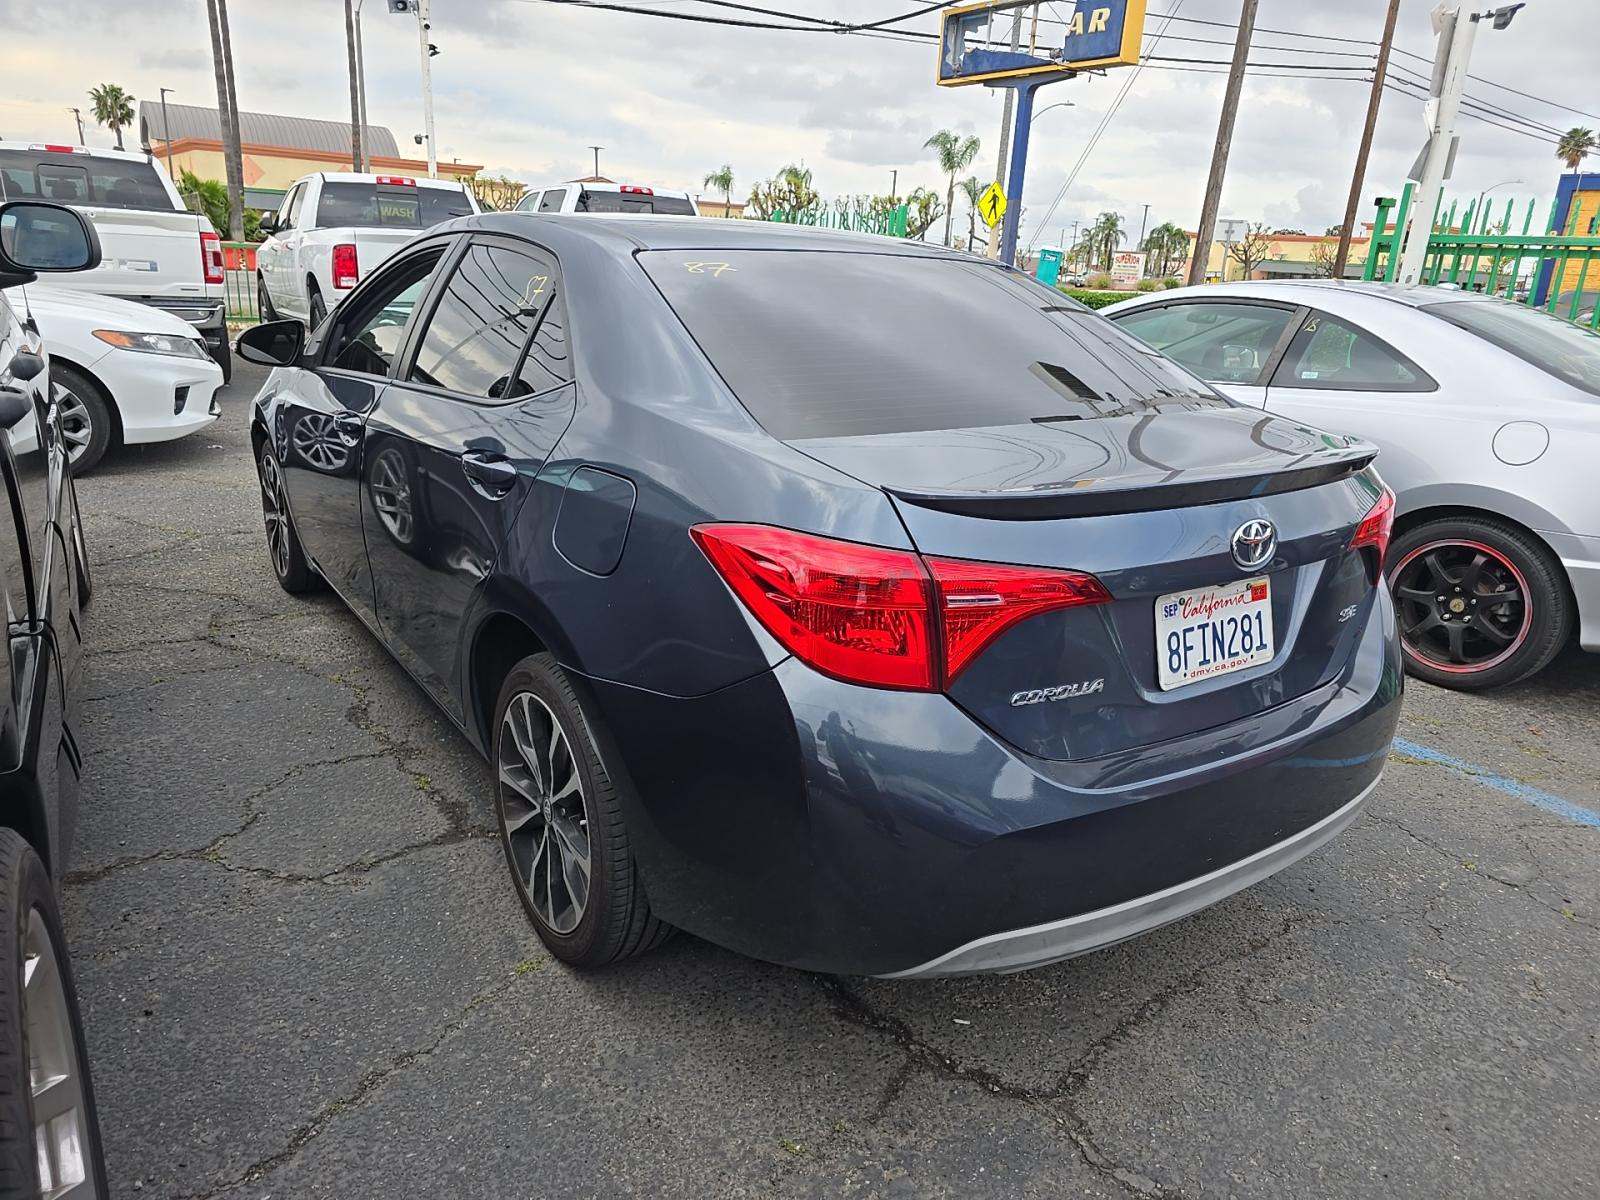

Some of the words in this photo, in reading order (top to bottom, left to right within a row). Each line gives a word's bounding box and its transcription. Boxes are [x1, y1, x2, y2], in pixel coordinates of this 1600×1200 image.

[381, 206, 417, 220] WASH
[683, 261, 738, 278] 87
[1164, 603, 1178, 618] SEP
[1182, 592, 1248, 620] California
[1338, 604, 1357, 622] SE
[1167, 610, 1268, 674] 8FIN281
[1190, 658, 1248, 678] dmv.ca.gov
[1010, 678, 1105, 706] COROLLA
